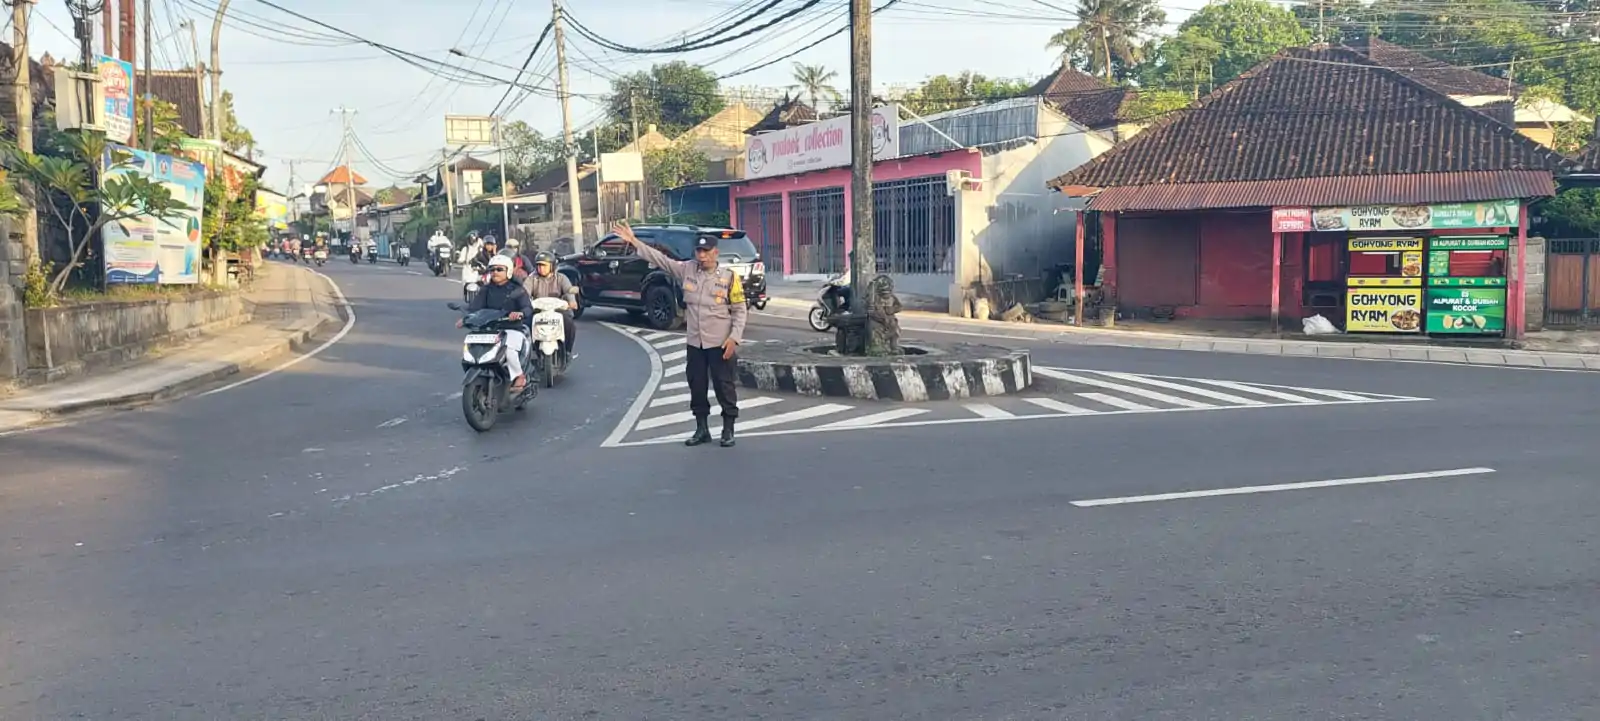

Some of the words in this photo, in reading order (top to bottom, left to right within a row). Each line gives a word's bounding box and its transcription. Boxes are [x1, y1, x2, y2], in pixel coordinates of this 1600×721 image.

[1351, 206, 1389, 217] GOHYONG
[1352, 240, 1393, 248] GOHYONG
[1351, 294, 1416, 306] GOHYONG
